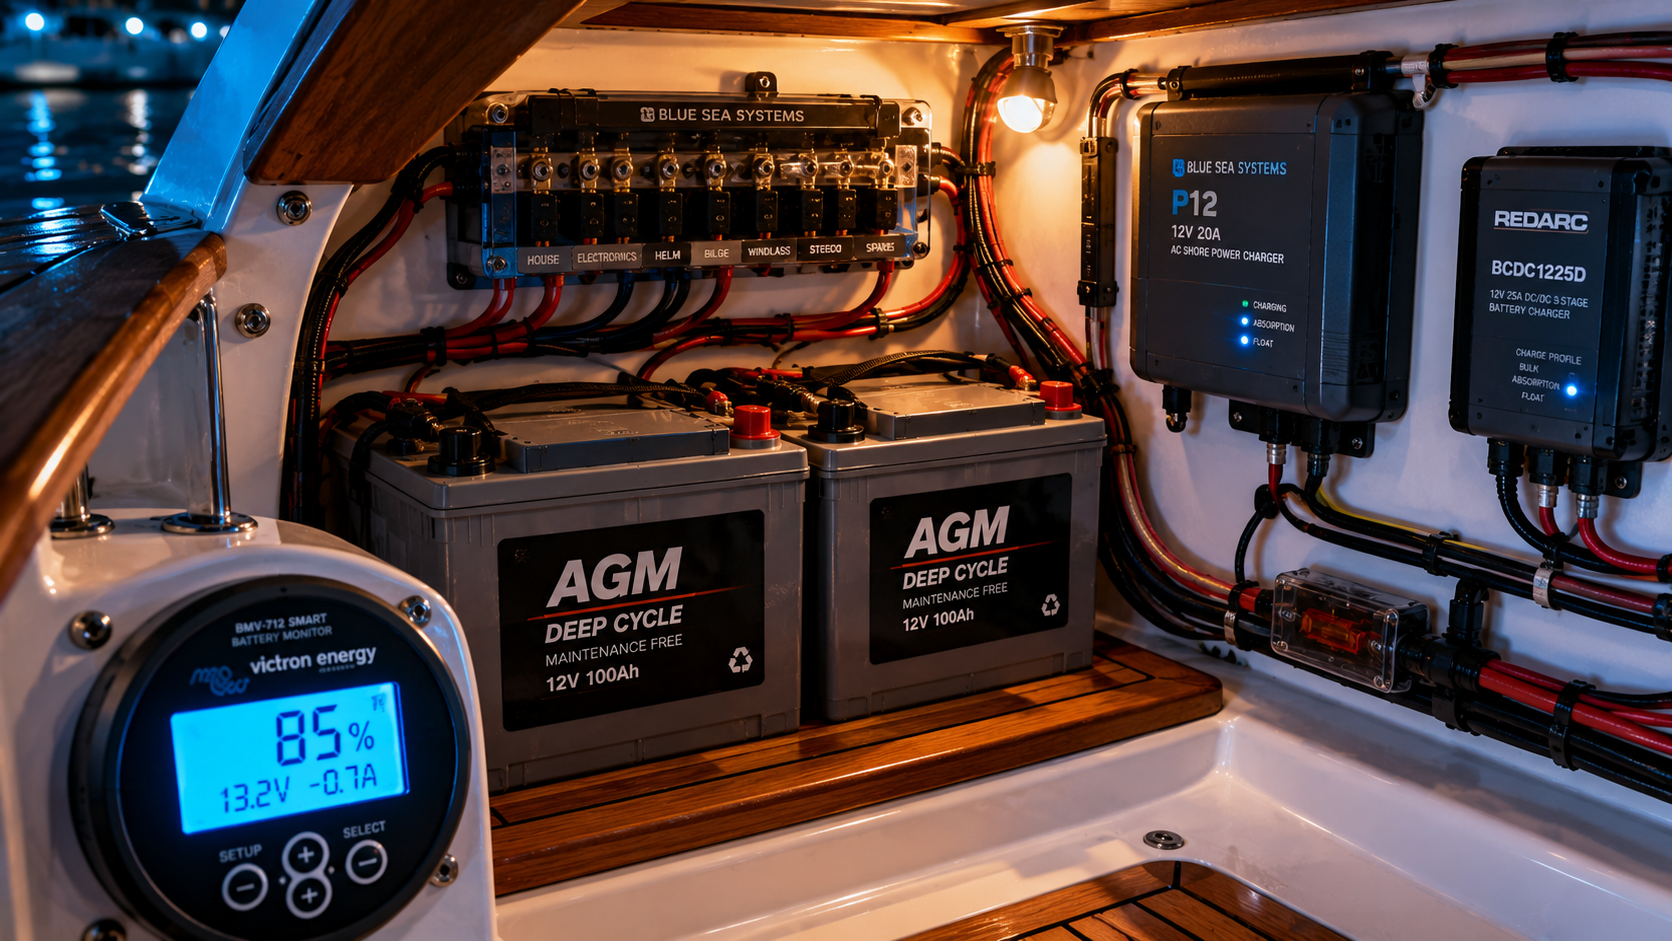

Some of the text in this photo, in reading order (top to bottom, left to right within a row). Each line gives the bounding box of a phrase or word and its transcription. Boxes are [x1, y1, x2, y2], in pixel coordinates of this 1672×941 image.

[658, 108, 805, 122] BLUE SEA SYSTEMS
[1187, 161, 1287, 175] BLUE SEA SYSTEMS
[1172, 189, 1218, 217] P12
[1494, 210, 1589, 231] REDARC
[1171, 225, 1221, 241] 12V 20A
[527, 254, 560, 265] HOUSE
[655, 250, 681, 260] HELM
[704, 248, 730, 258] BILGE
[748, 246, 791, 256] WINDLASS
[1171, 245, 1285, 264] AC SHORE POWER CHARGER
[1491, 260, 1587, 283] BCDC1225D
[1490, 289, 1505, 299] 12V
[1525, 293, 1552, 304] DC/DC
[1560, 297, 1589, 308] STAGE
[1489, 303, 1571, 319] BATTERY CHARGER
[1515, 348, 1582, 365] CHARGE PROFILE
[1519, 362, 1539, 373] BULK
[903, 505, 1011, 559] AGM
[545, 545, 683, 609] AGM
[902, 556, 1009, 590] DEEP CYCLE
[902, 582, 1009, 610] MAINTENANCE FREE
[235, 613, 328, 634] BMV-712 SMART
[544, 604, 684, 644] DEEP CYCLE
[902, 607, 975, 632] 12V 100Ah
[232, 625, 333, 647] BATTERY MONITOR
[250, 654, 312, 674] victron
[316, 647, 377, 666] energy
[545, 633, 683, 667] MAINTENANCE FREE
[546, 664, 640, 692] 12V 100Ah
[219, 763, 378, 814] 13.2V -0.7A
[342, 820, 387, 839] SELECT
[218, 843, 263, 863] SETUP
